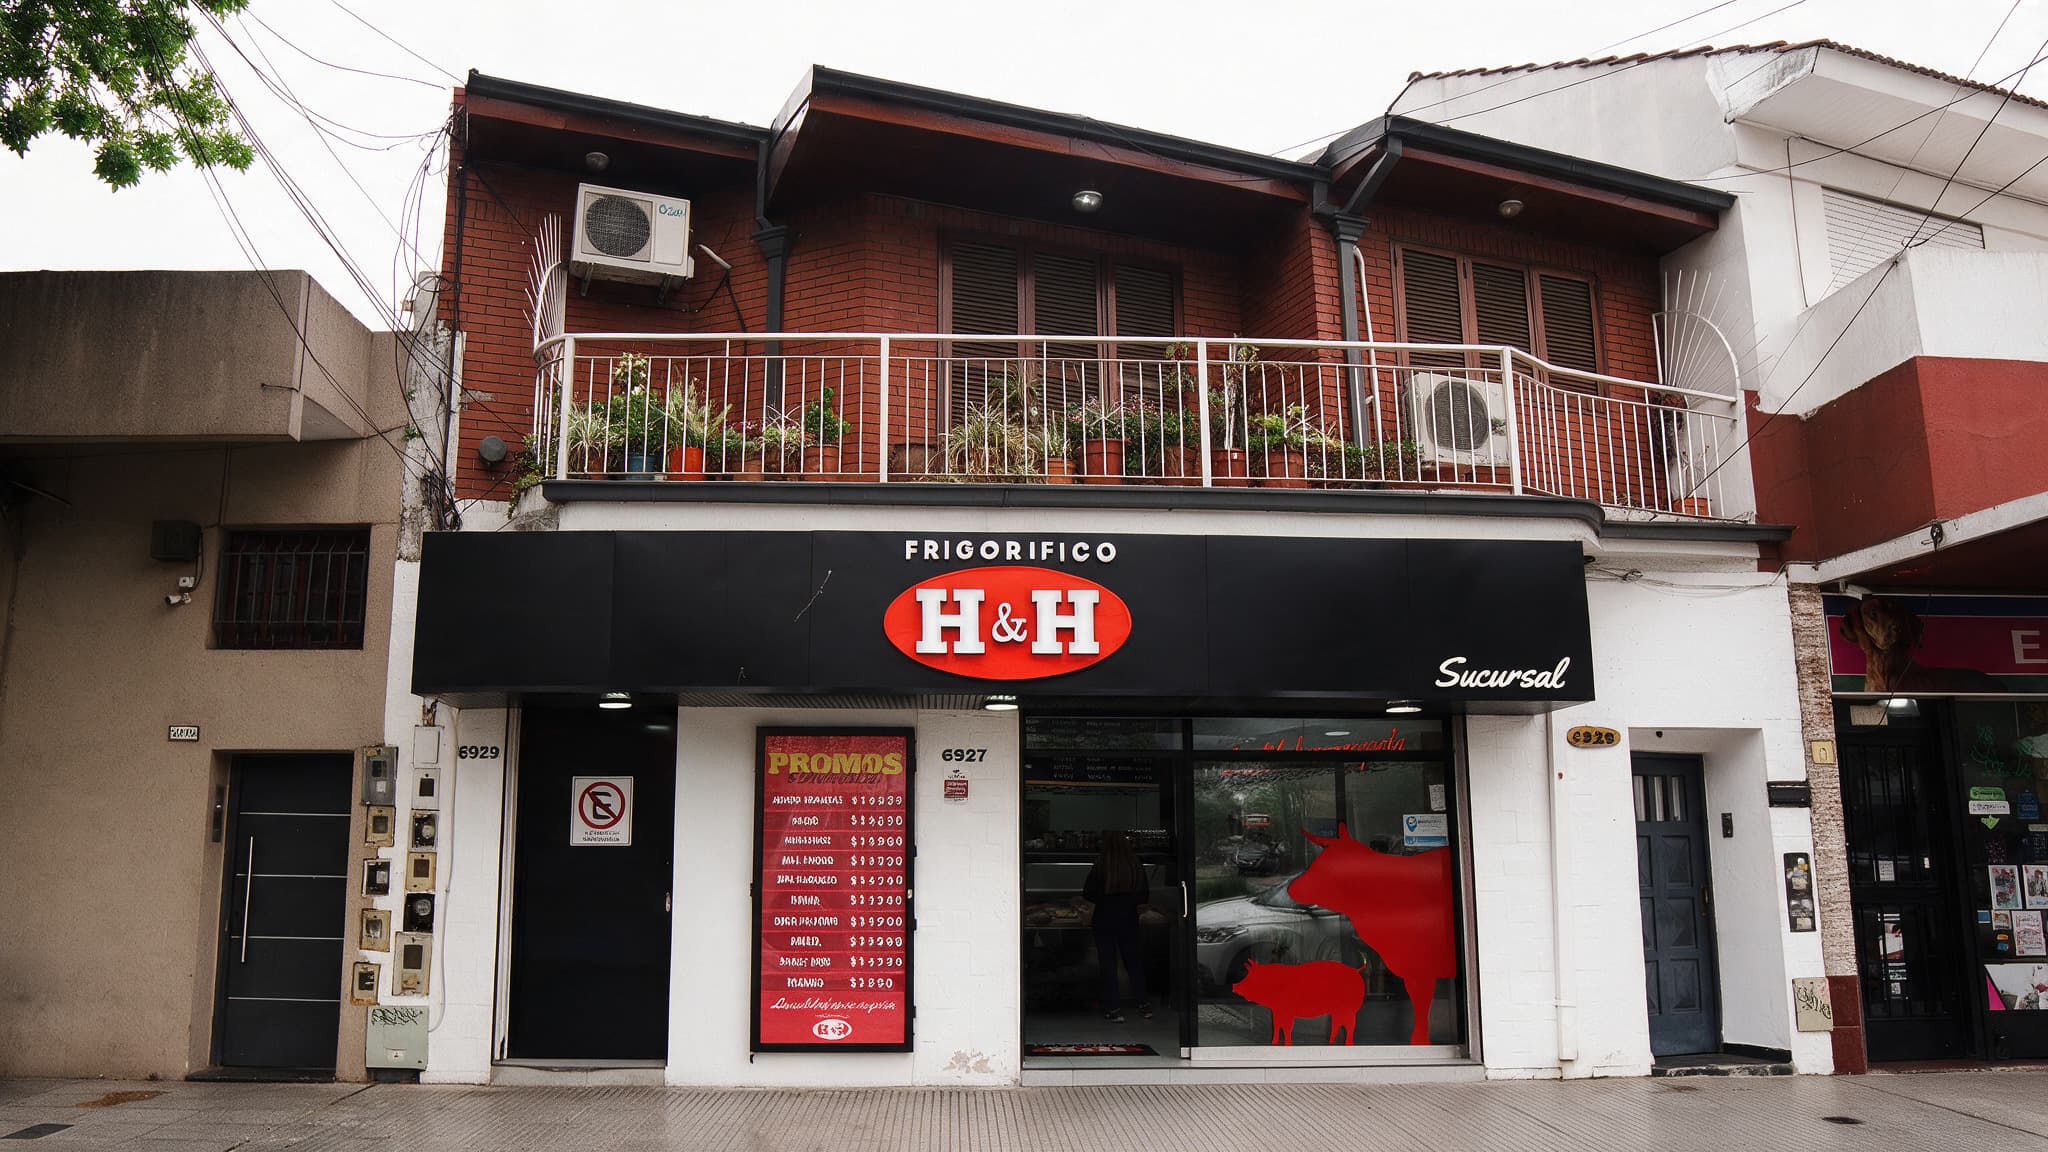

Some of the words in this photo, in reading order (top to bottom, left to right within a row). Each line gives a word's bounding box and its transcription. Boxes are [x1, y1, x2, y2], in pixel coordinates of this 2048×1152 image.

[905, 539, 1117, 563] FRIGORIFICO
[1435, 656, 1571, 689] Sucursal
[458, 745, 500, 760] 6929
[768, 752, 903, 775] PROMOS
[942, 748, 988, 763] 6927
